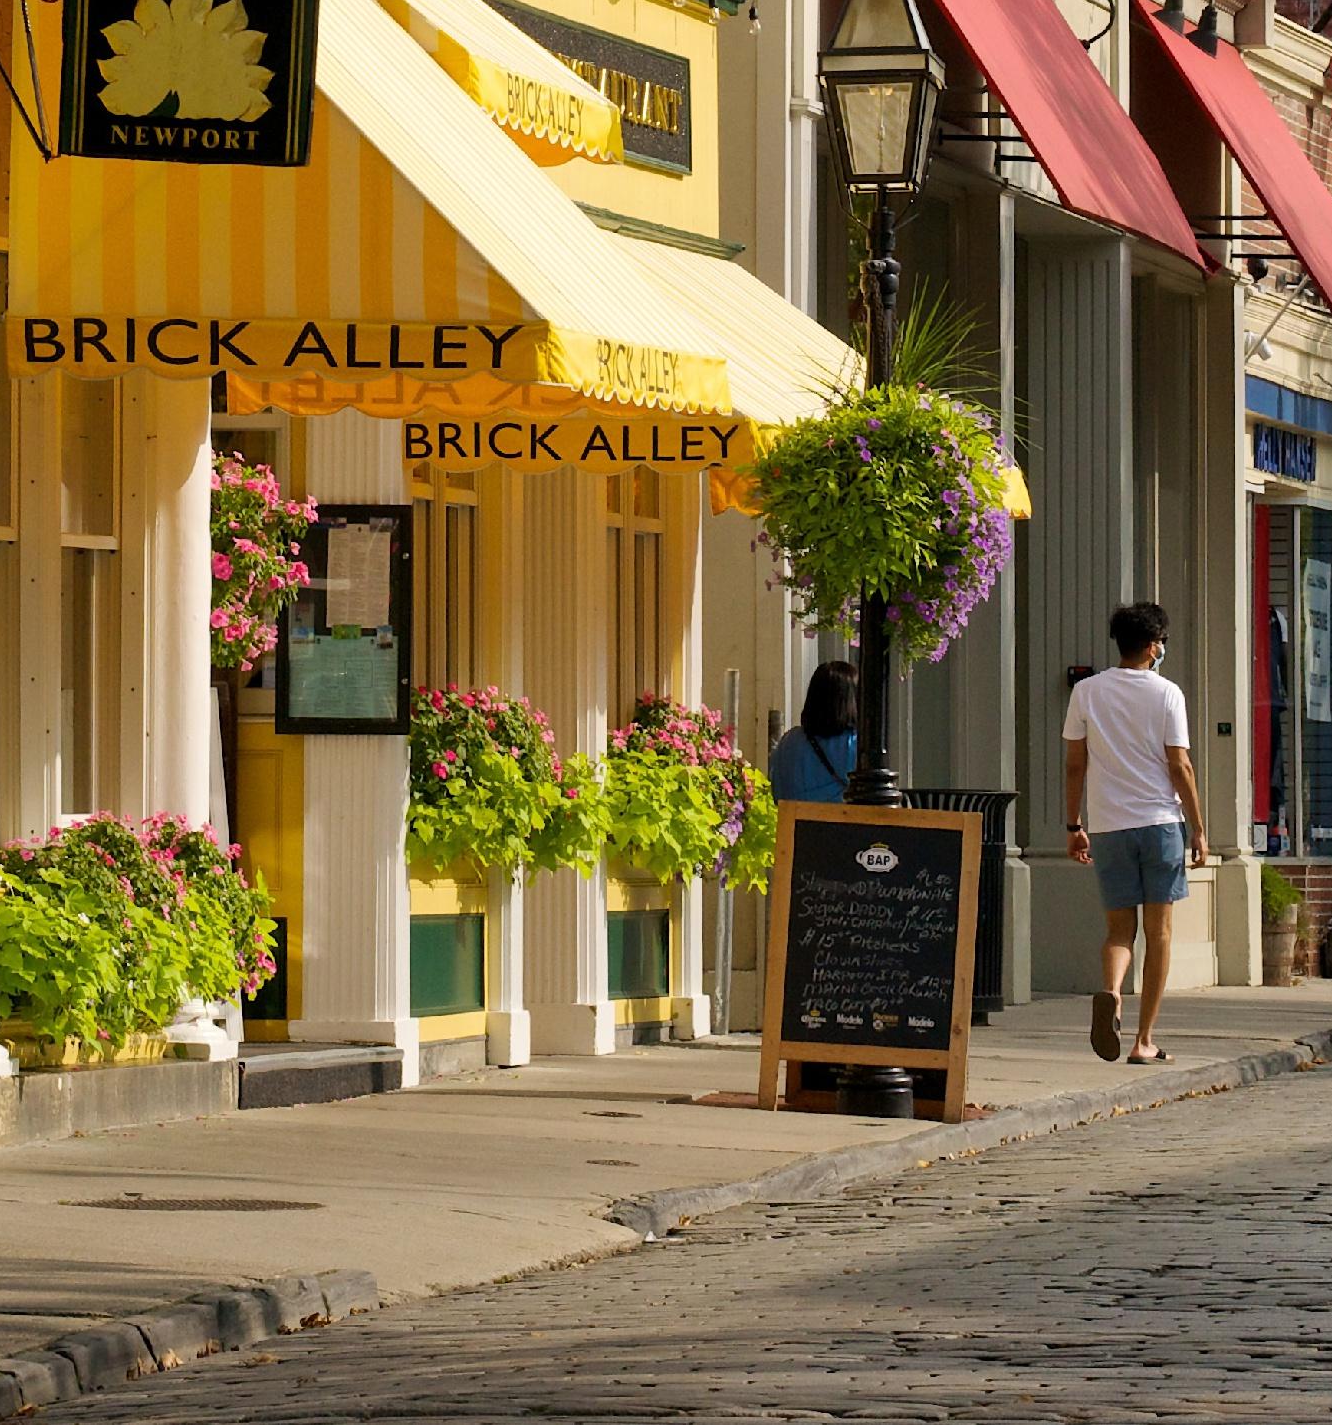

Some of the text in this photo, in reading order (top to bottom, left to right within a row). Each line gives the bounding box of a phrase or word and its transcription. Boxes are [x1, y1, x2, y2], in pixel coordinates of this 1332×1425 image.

[507, 72, 584, 140] BRICK ALLEY
[110, 123, 261, 152] NEWPORT
[24, 316, 527, 371] BRICK ALLEY
[596, 338, 637, 391] BRICK
[640, 347, 678, 396] ALLEY
[405, 422, 740, 462] BRICK ALLEY
[867, 854, 891, 866] BAP
[836, 1013, 864, 1025] Modelo
[908, 1015, 935, 1027] Modelo
